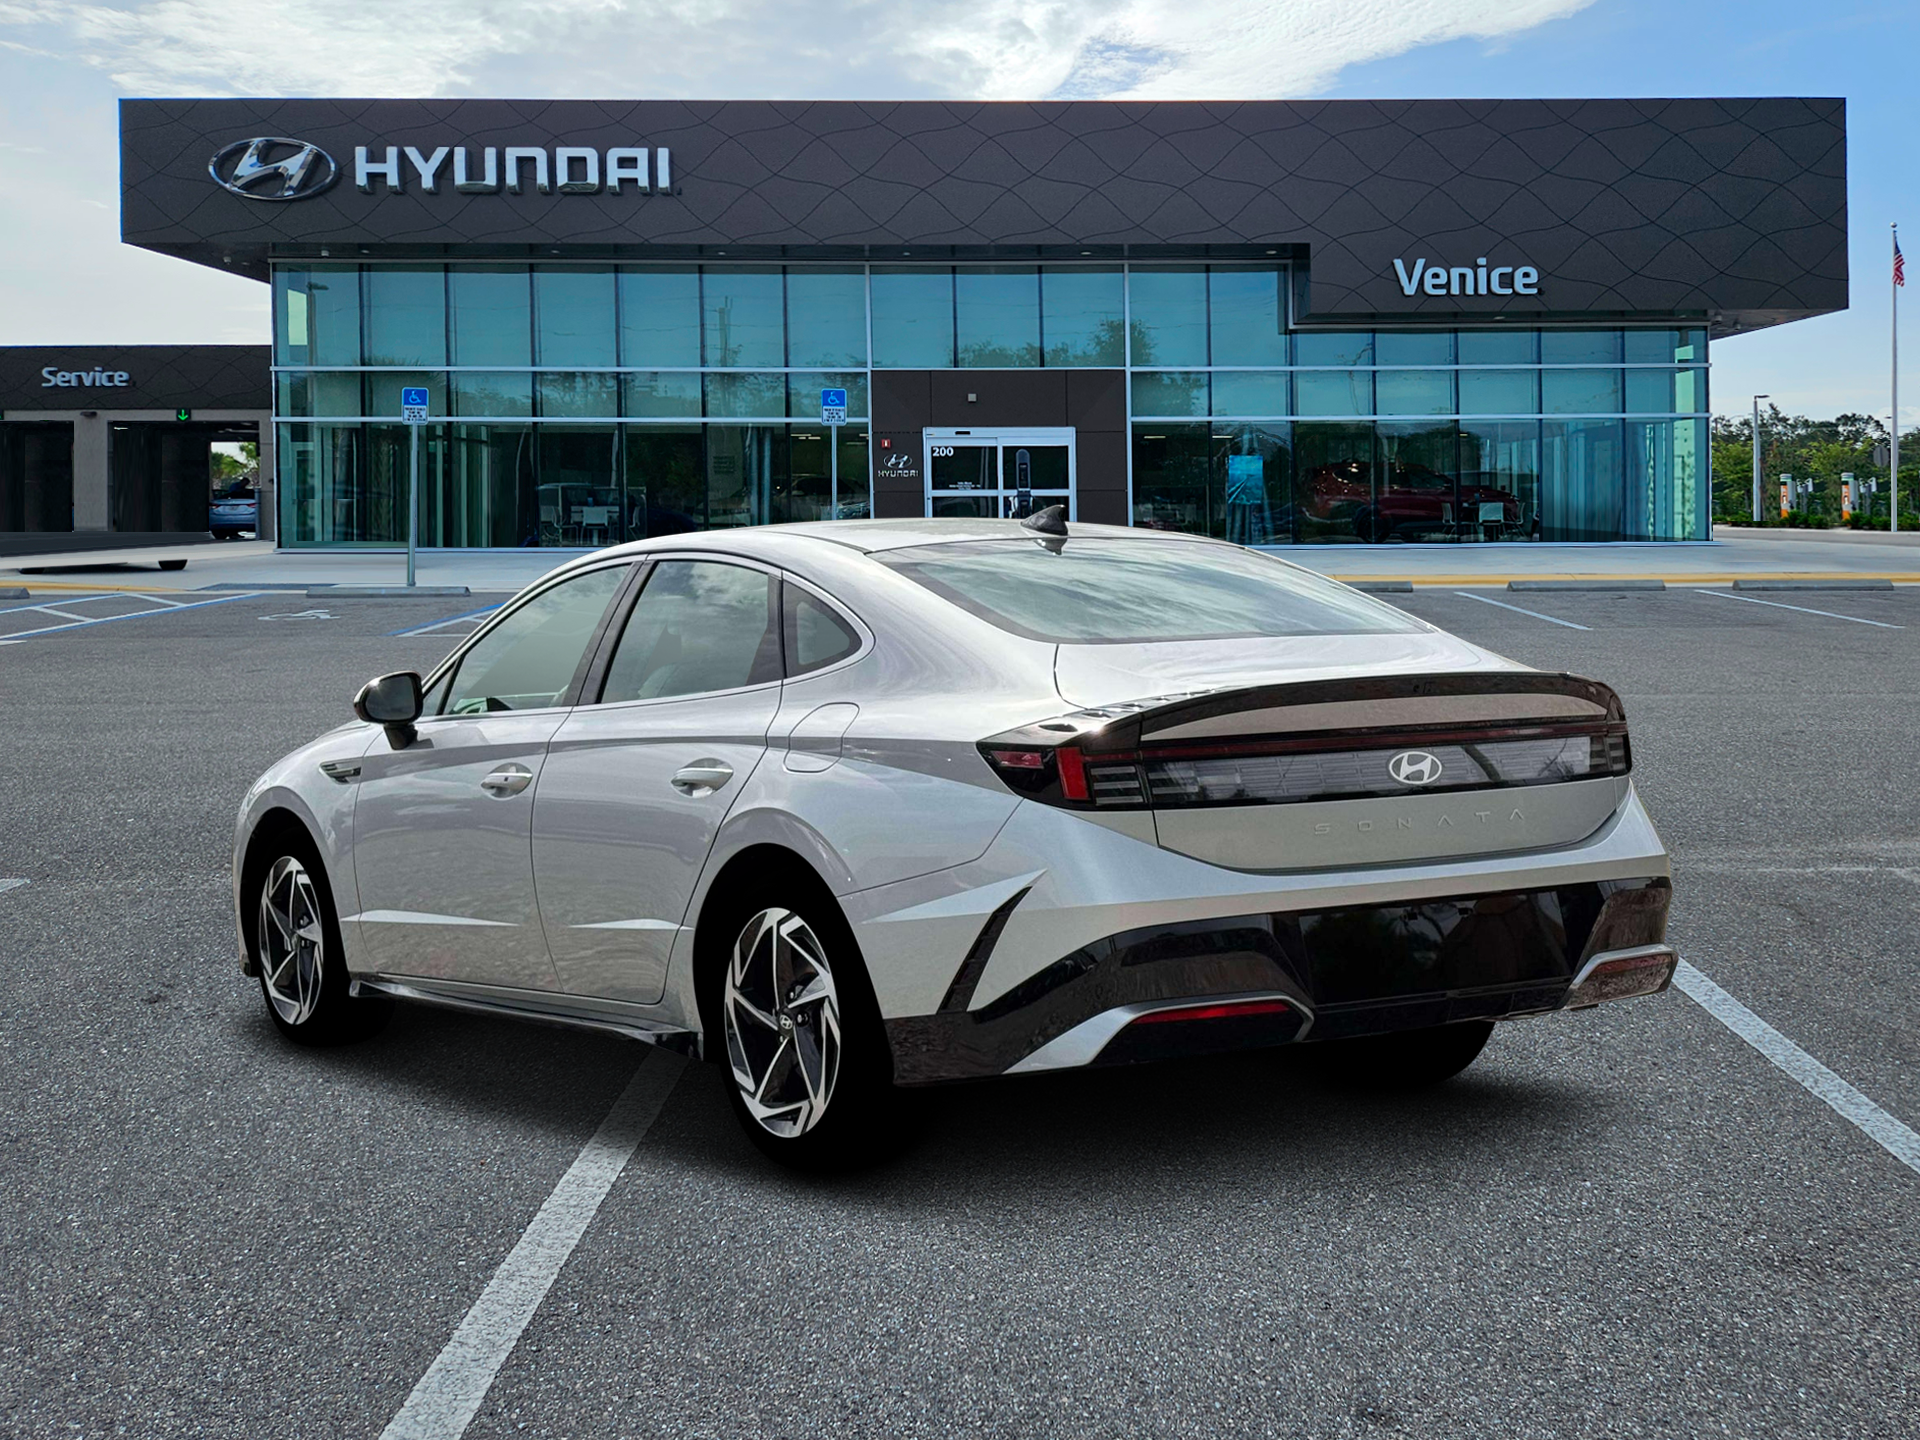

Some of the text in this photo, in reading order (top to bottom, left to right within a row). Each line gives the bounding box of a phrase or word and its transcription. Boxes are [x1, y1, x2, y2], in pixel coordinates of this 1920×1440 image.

[355, 146, 670, 193] HYUNDAI
[1393, 257, 1538, 296] Venice
[41, 366, 130, 388] Service
[932, 446, 954, 457] 200
[878, 470, 919, 478] HYUNDAI
[1314, 808, 1525, 835] SONATA
